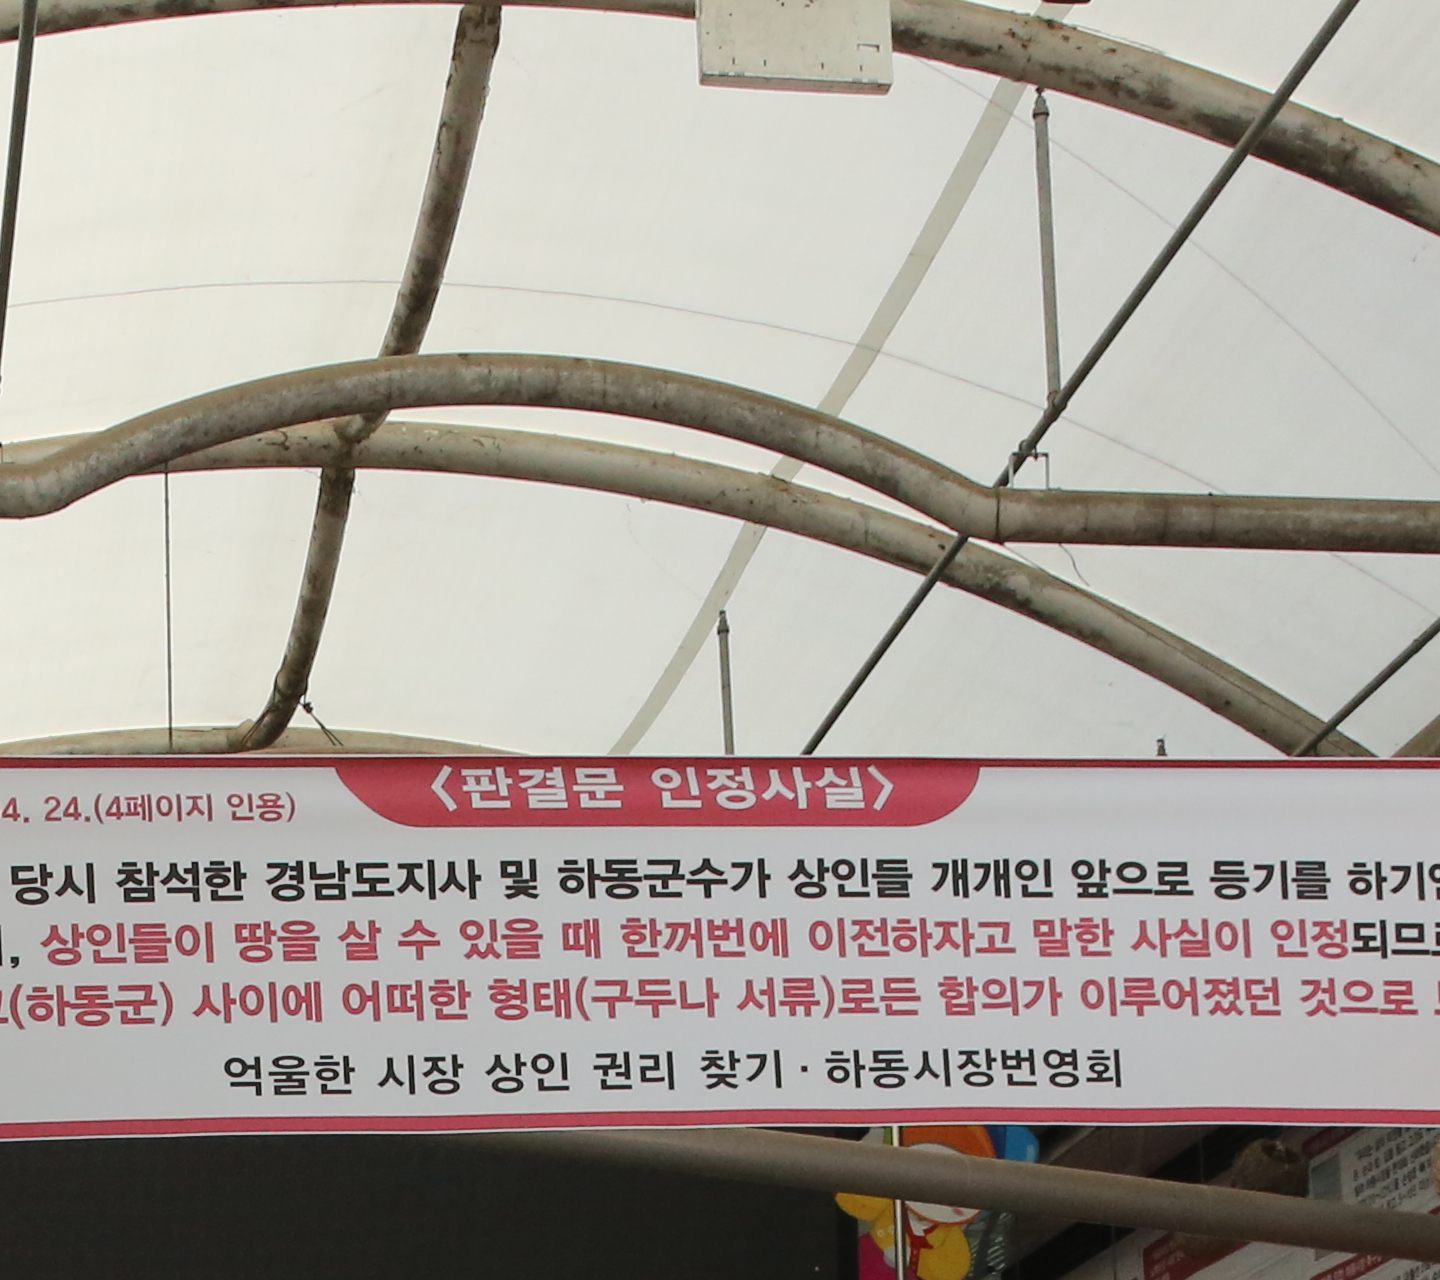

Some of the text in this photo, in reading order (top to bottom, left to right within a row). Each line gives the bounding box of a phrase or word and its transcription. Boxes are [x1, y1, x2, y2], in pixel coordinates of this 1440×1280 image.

[47, 793, 216, 826] 24.(4페이지
[226, 791, 296, 825] 인용)
[12, 862, 95, 909] 당시
[115, 860, 245, 906] 참석한
[265, 859, 480, 904] 경남도지사
[500, 858, 540, 902] 및
[558, 856, 770, 905] 하동군수가
[787, 858, 910, 903] 상인들
[933, 858, 1051, 900] 개개인
[1072, 858, 1191, 901] 앞으로
[1210, 860, 1332, 901] 등기를
[39, 921, 215, 969] 상인들이
[233, 919, 320, 964] 땅을
[337, 919, 379, 964] 살
[398, 919, 438, 961] 수
[459, 918, 541, 962] 있을
[560, 918, 601, 960] 때
[621, 918, 789, 960] 한꺼번에
[808, 918, 1015, 959] 이전하자고
[1033, 917, 1114, 960] 말한
[1131, 917, 1252, 960] 사실이
[192, 980, 323, 1025] 사이에
[342, 978, 471, 1024] 어떠한
[487, 975, 721, 1022] 형태(구두나
[739, 974, 920, 1020] 서류)로든
[939, 974, 1063, 1019] 합의가
[1080, 976, 1281, 1020] 이루어졌던
[1299, 978, 1416, 1021] 것으로
[223, 1045, 1125, 1098] 억울한 시장 상인 권리 찾기 하동시장번영회
